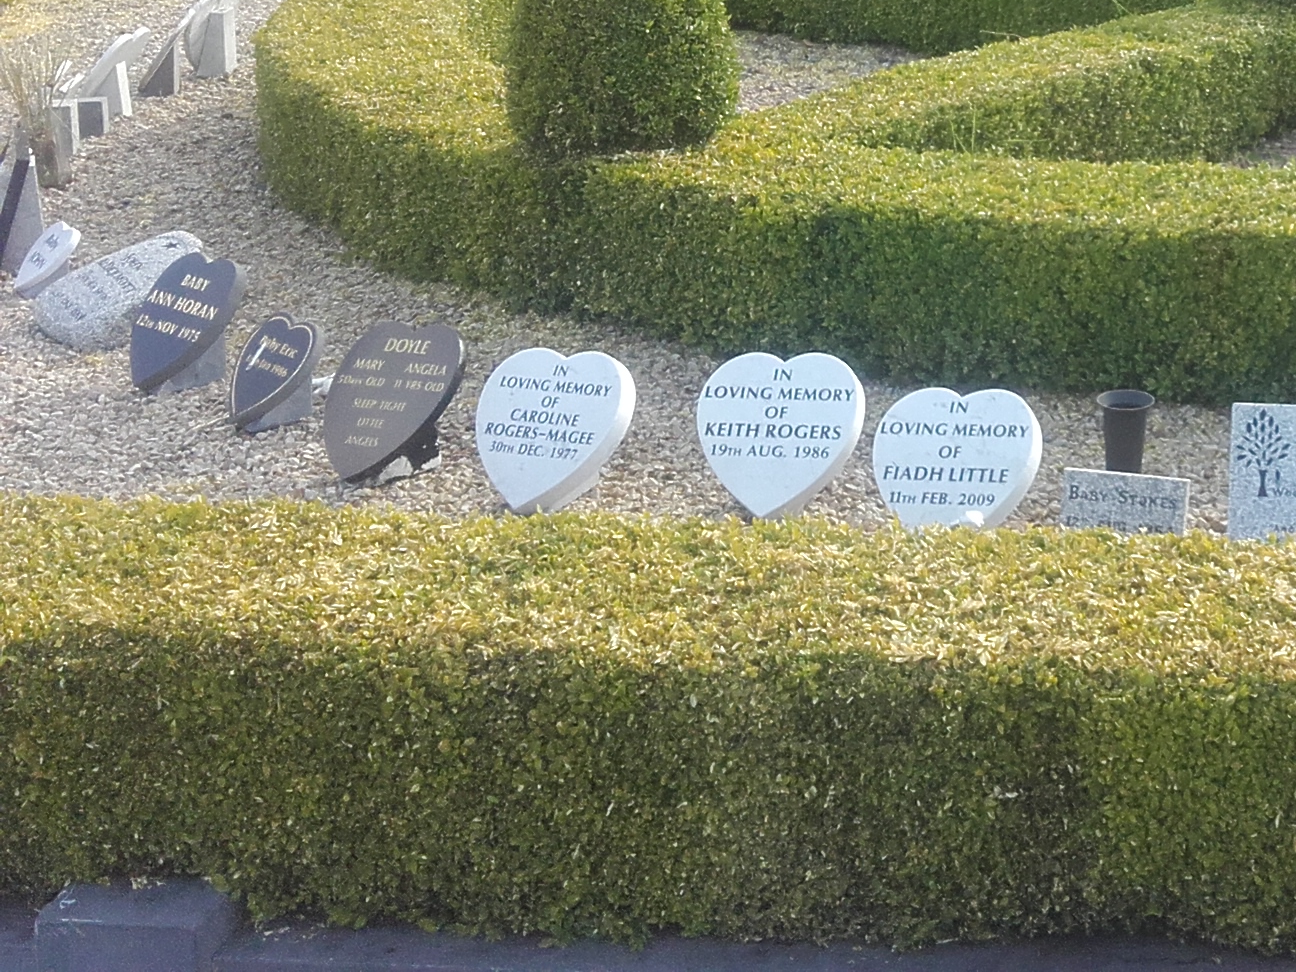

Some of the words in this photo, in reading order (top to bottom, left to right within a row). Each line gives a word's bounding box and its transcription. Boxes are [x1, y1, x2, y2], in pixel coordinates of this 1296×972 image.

[180, 274, 211, 292] BABY
[147, 289, 176, 307] ANN
[173, 297, 219, 321] HORAN
[154, 320, 179, 335] NOV
[177, 326, 201, 343] 1975
[384, 338, 431, 355] DOYLE
[353, 358, 385, 371] MARY
[404, 363, 447, 376] ANGELA
[553, 365, 570, 377] IN
[773, 368, 793, 381] IN
[365, 376, 386, 387] OLD
[425, 382, 445, 392] OLD
[500, 376, 551, 392] LOVING
[553, 381, 612, 397] MEMORY
[541, 395, 560, 409] OF
[704, 385, 773, 400] LOVING
[777, 387, 855, 402] MEMORY
[352, 398, 377, 409] SLEEP
[380, 400, 407, 412] TIGHT
[764, 406, 788, 419] OF
[949, 401, 969, 414] IN
[356, 417, 385, 429] LITTLE
[510, 408, 580, 427] CAROLINE
[484, 422, 595, 446] ROGERS-MAGEE
[704, 422, 760, 438] KEITH
[765, 424, 842, 440] ROGERS
[880, 421, 948, 436] LOVING
[952, 423, 1029, 438] MEMORY
[344, 435, 380, 447] ANGELS
[518, 443, 544, 457] DEC.
[550, 447, 578, 460] 1977
[746, 444, 787, 458] AUG.
[794, 446, 830, 459] 1986
[938, 445, 962, 459] OF
[883, 465, 944, 481] FIADH
[948, 467, 1009, 484] LITTLE
[921, 492, 951, 505] FEB.
[958, 493, 996, 506] 2009
